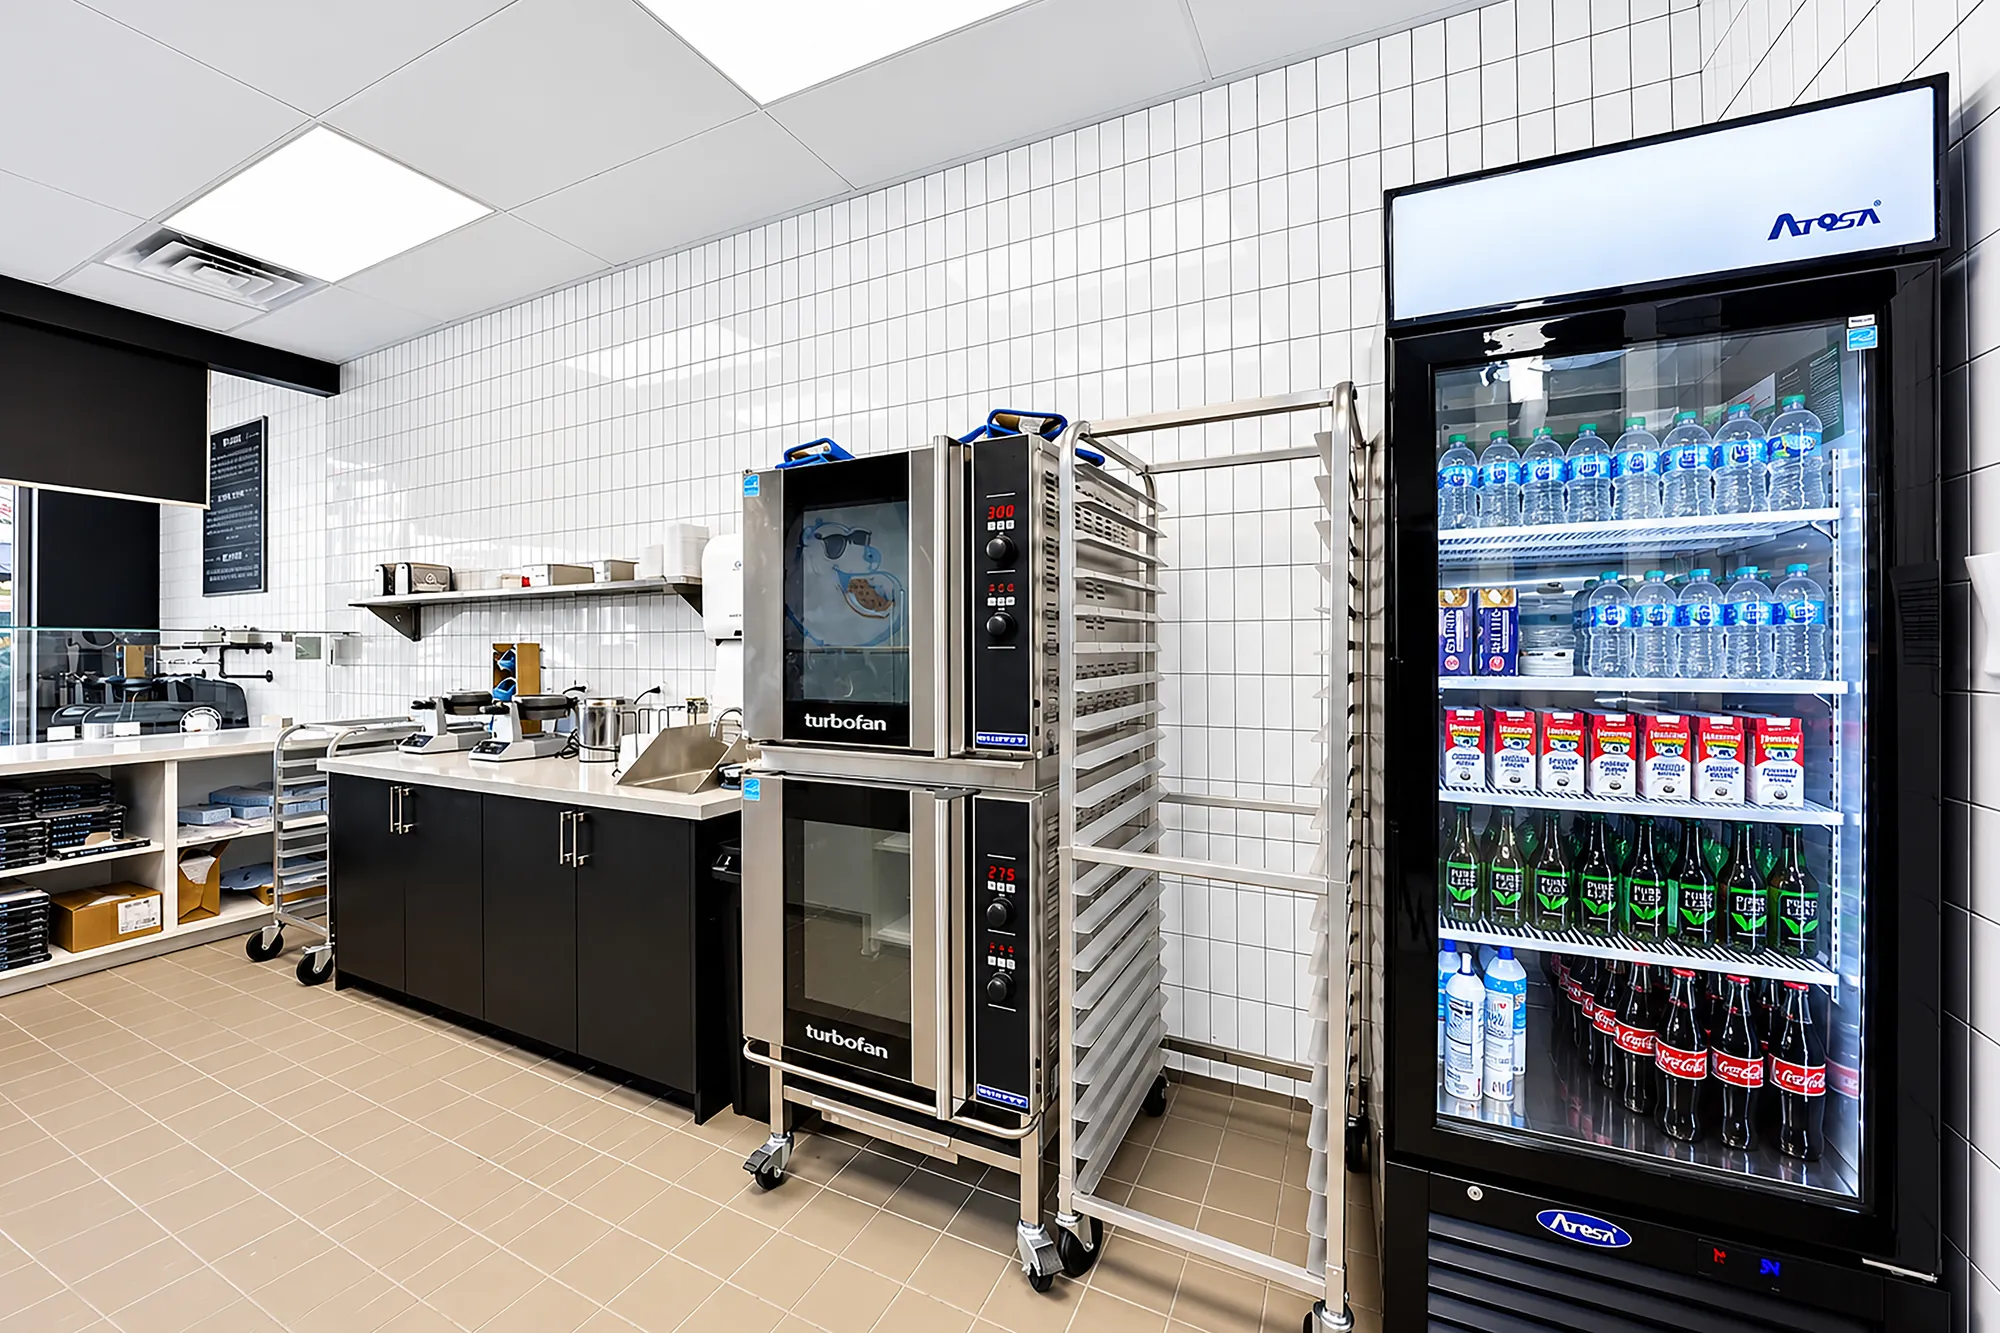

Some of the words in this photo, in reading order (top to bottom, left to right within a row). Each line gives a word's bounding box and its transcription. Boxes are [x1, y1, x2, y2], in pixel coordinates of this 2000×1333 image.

[987, 504, 1015, 520] 300
[804, 713, 887, 731] turbofan
[988, 865, 1015, 882] 275
[805, 1023, 889, 1060] turbofan
